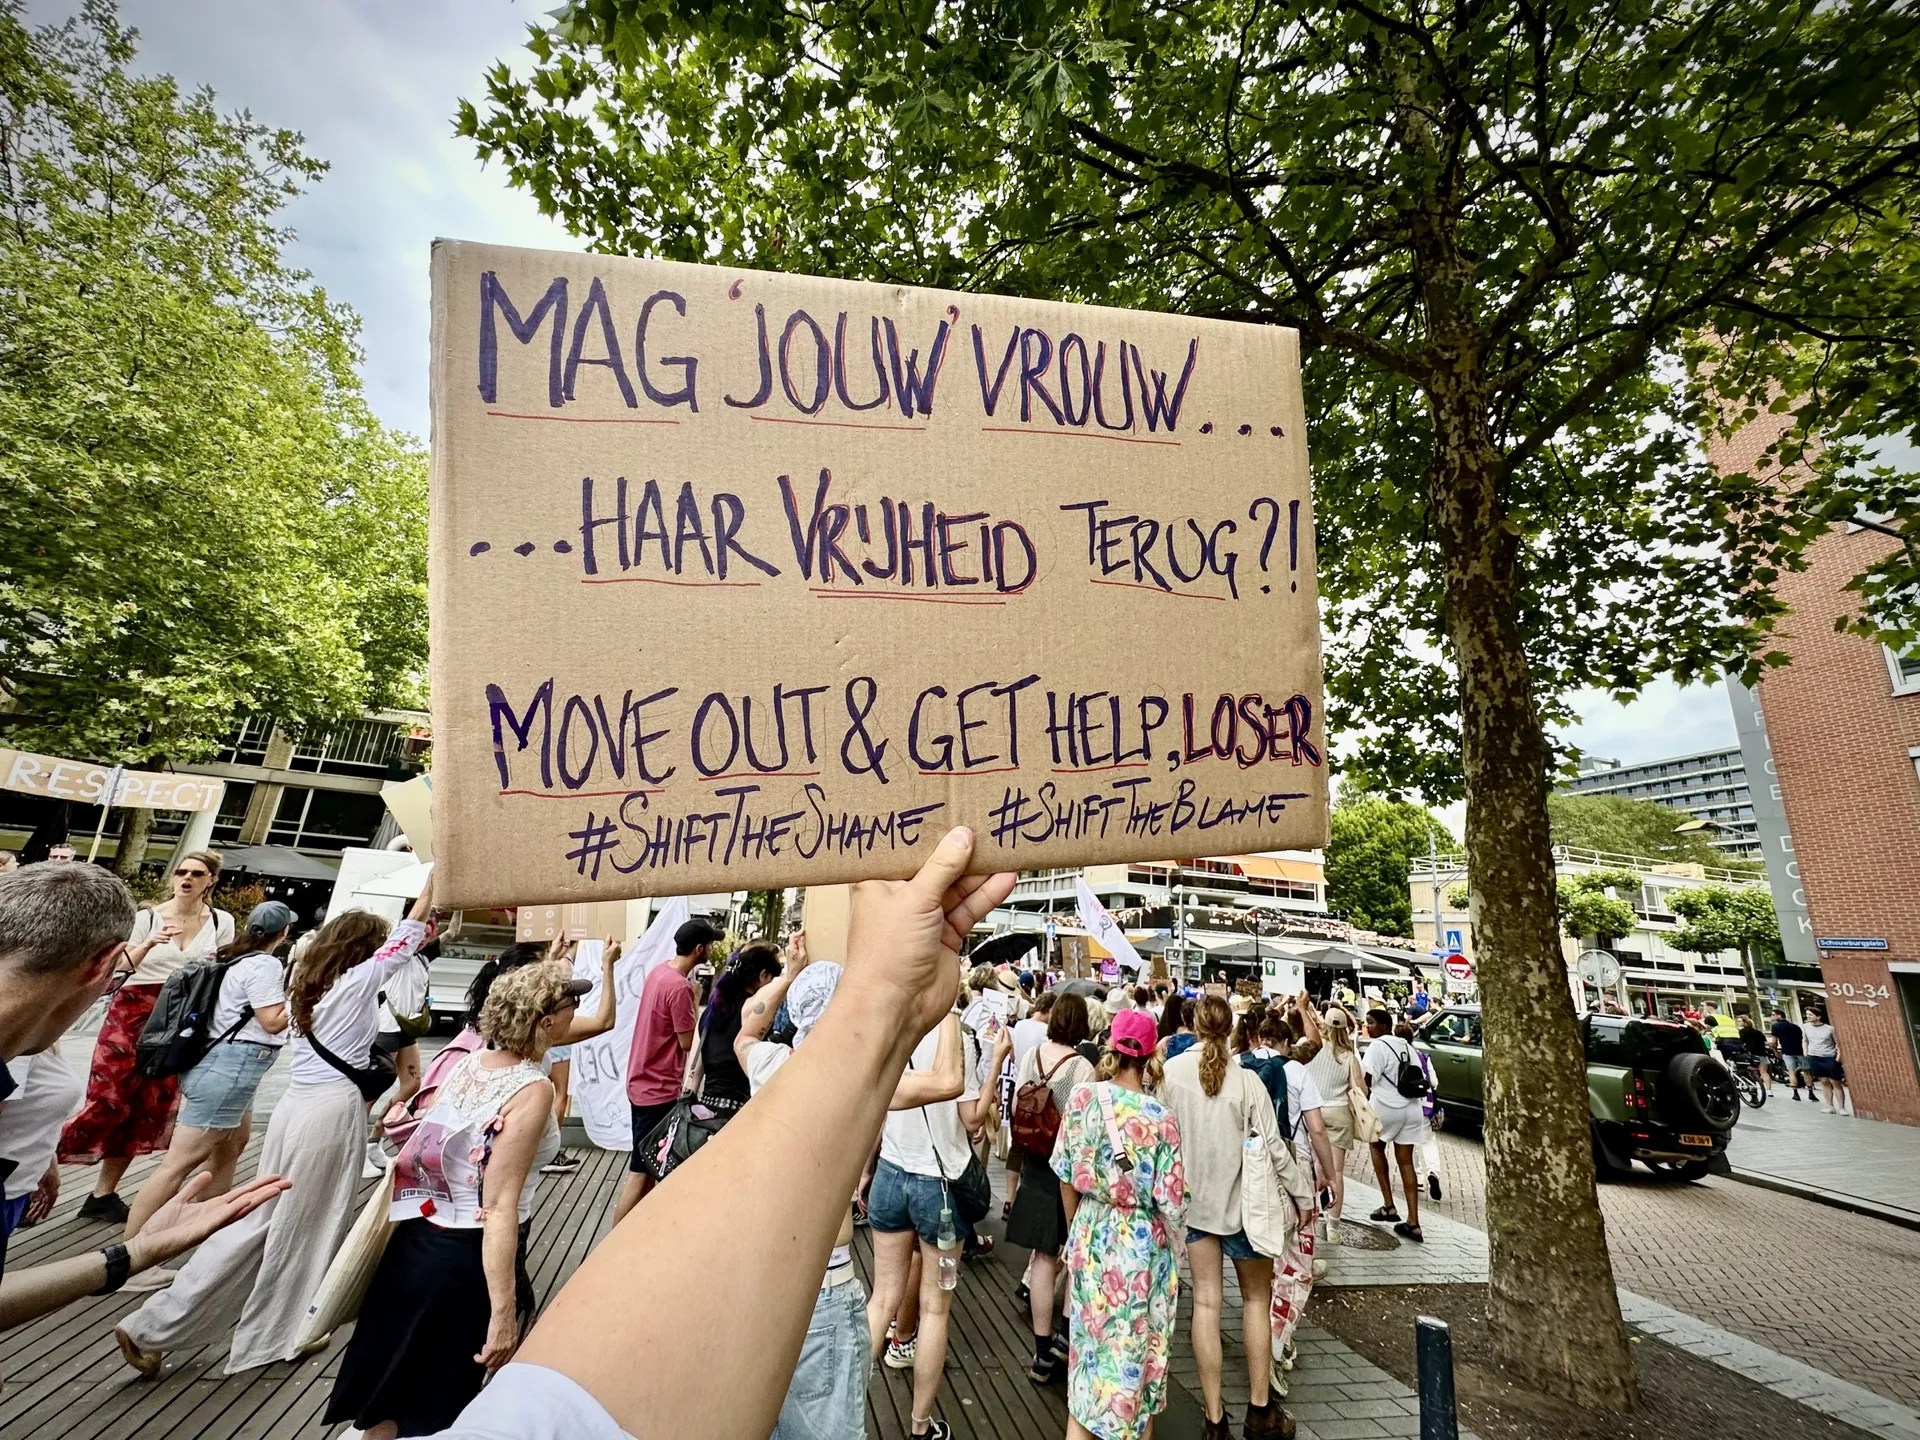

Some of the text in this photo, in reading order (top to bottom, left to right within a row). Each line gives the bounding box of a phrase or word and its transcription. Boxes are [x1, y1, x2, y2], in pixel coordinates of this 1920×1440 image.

[478, 270, 699, 413] MAG
[777, 467, 1037, 593] VRIJHEID
[1059, 496, 1300, 601] TERUG?!
[485, 677, 678, 790] MOVE
[691, 683, 830, 776] OUT
[841, 676, 889, 784] &
[908, 674, 1041, 773] GET
[1182, 692, 1322, 770] LOSER
[1829, 982, 1891, 999] 30-34
